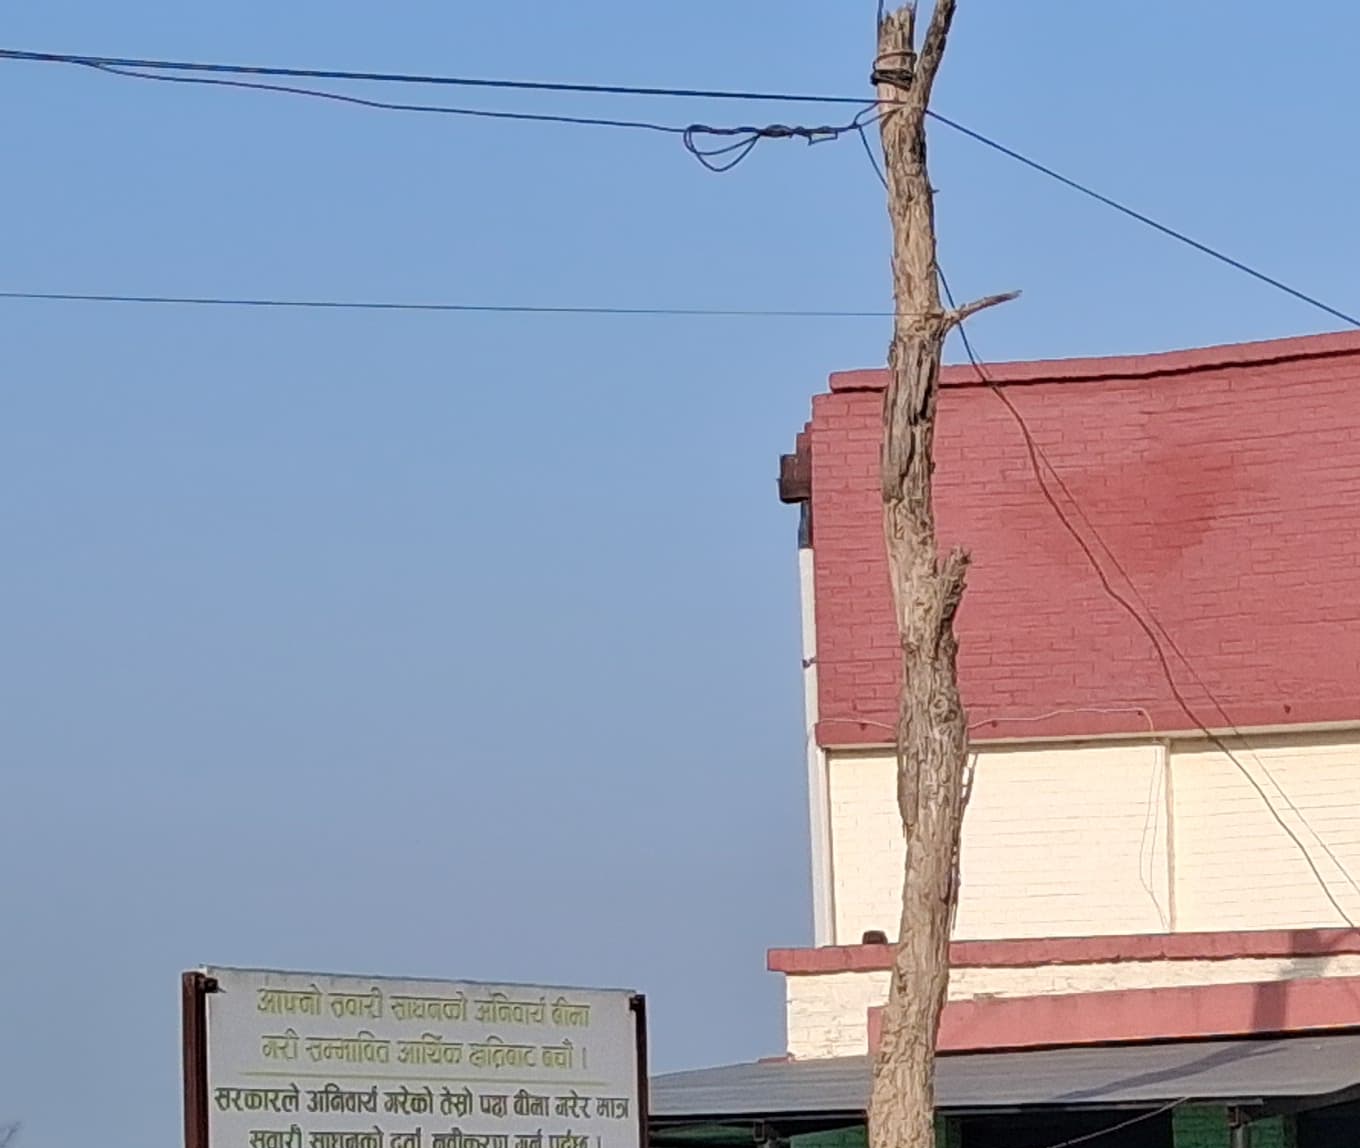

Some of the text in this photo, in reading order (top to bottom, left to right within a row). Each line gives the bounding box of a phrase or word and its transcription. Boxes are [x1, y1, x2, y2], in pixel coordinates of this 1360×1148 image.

[214, 1082, 300, 1113] सरकारले
[305, 1082, 378, 1114] अनिवार्य
[383, 1085, 434, 1115] गरेको
[554, 1090, 592, 1119] गरेर
